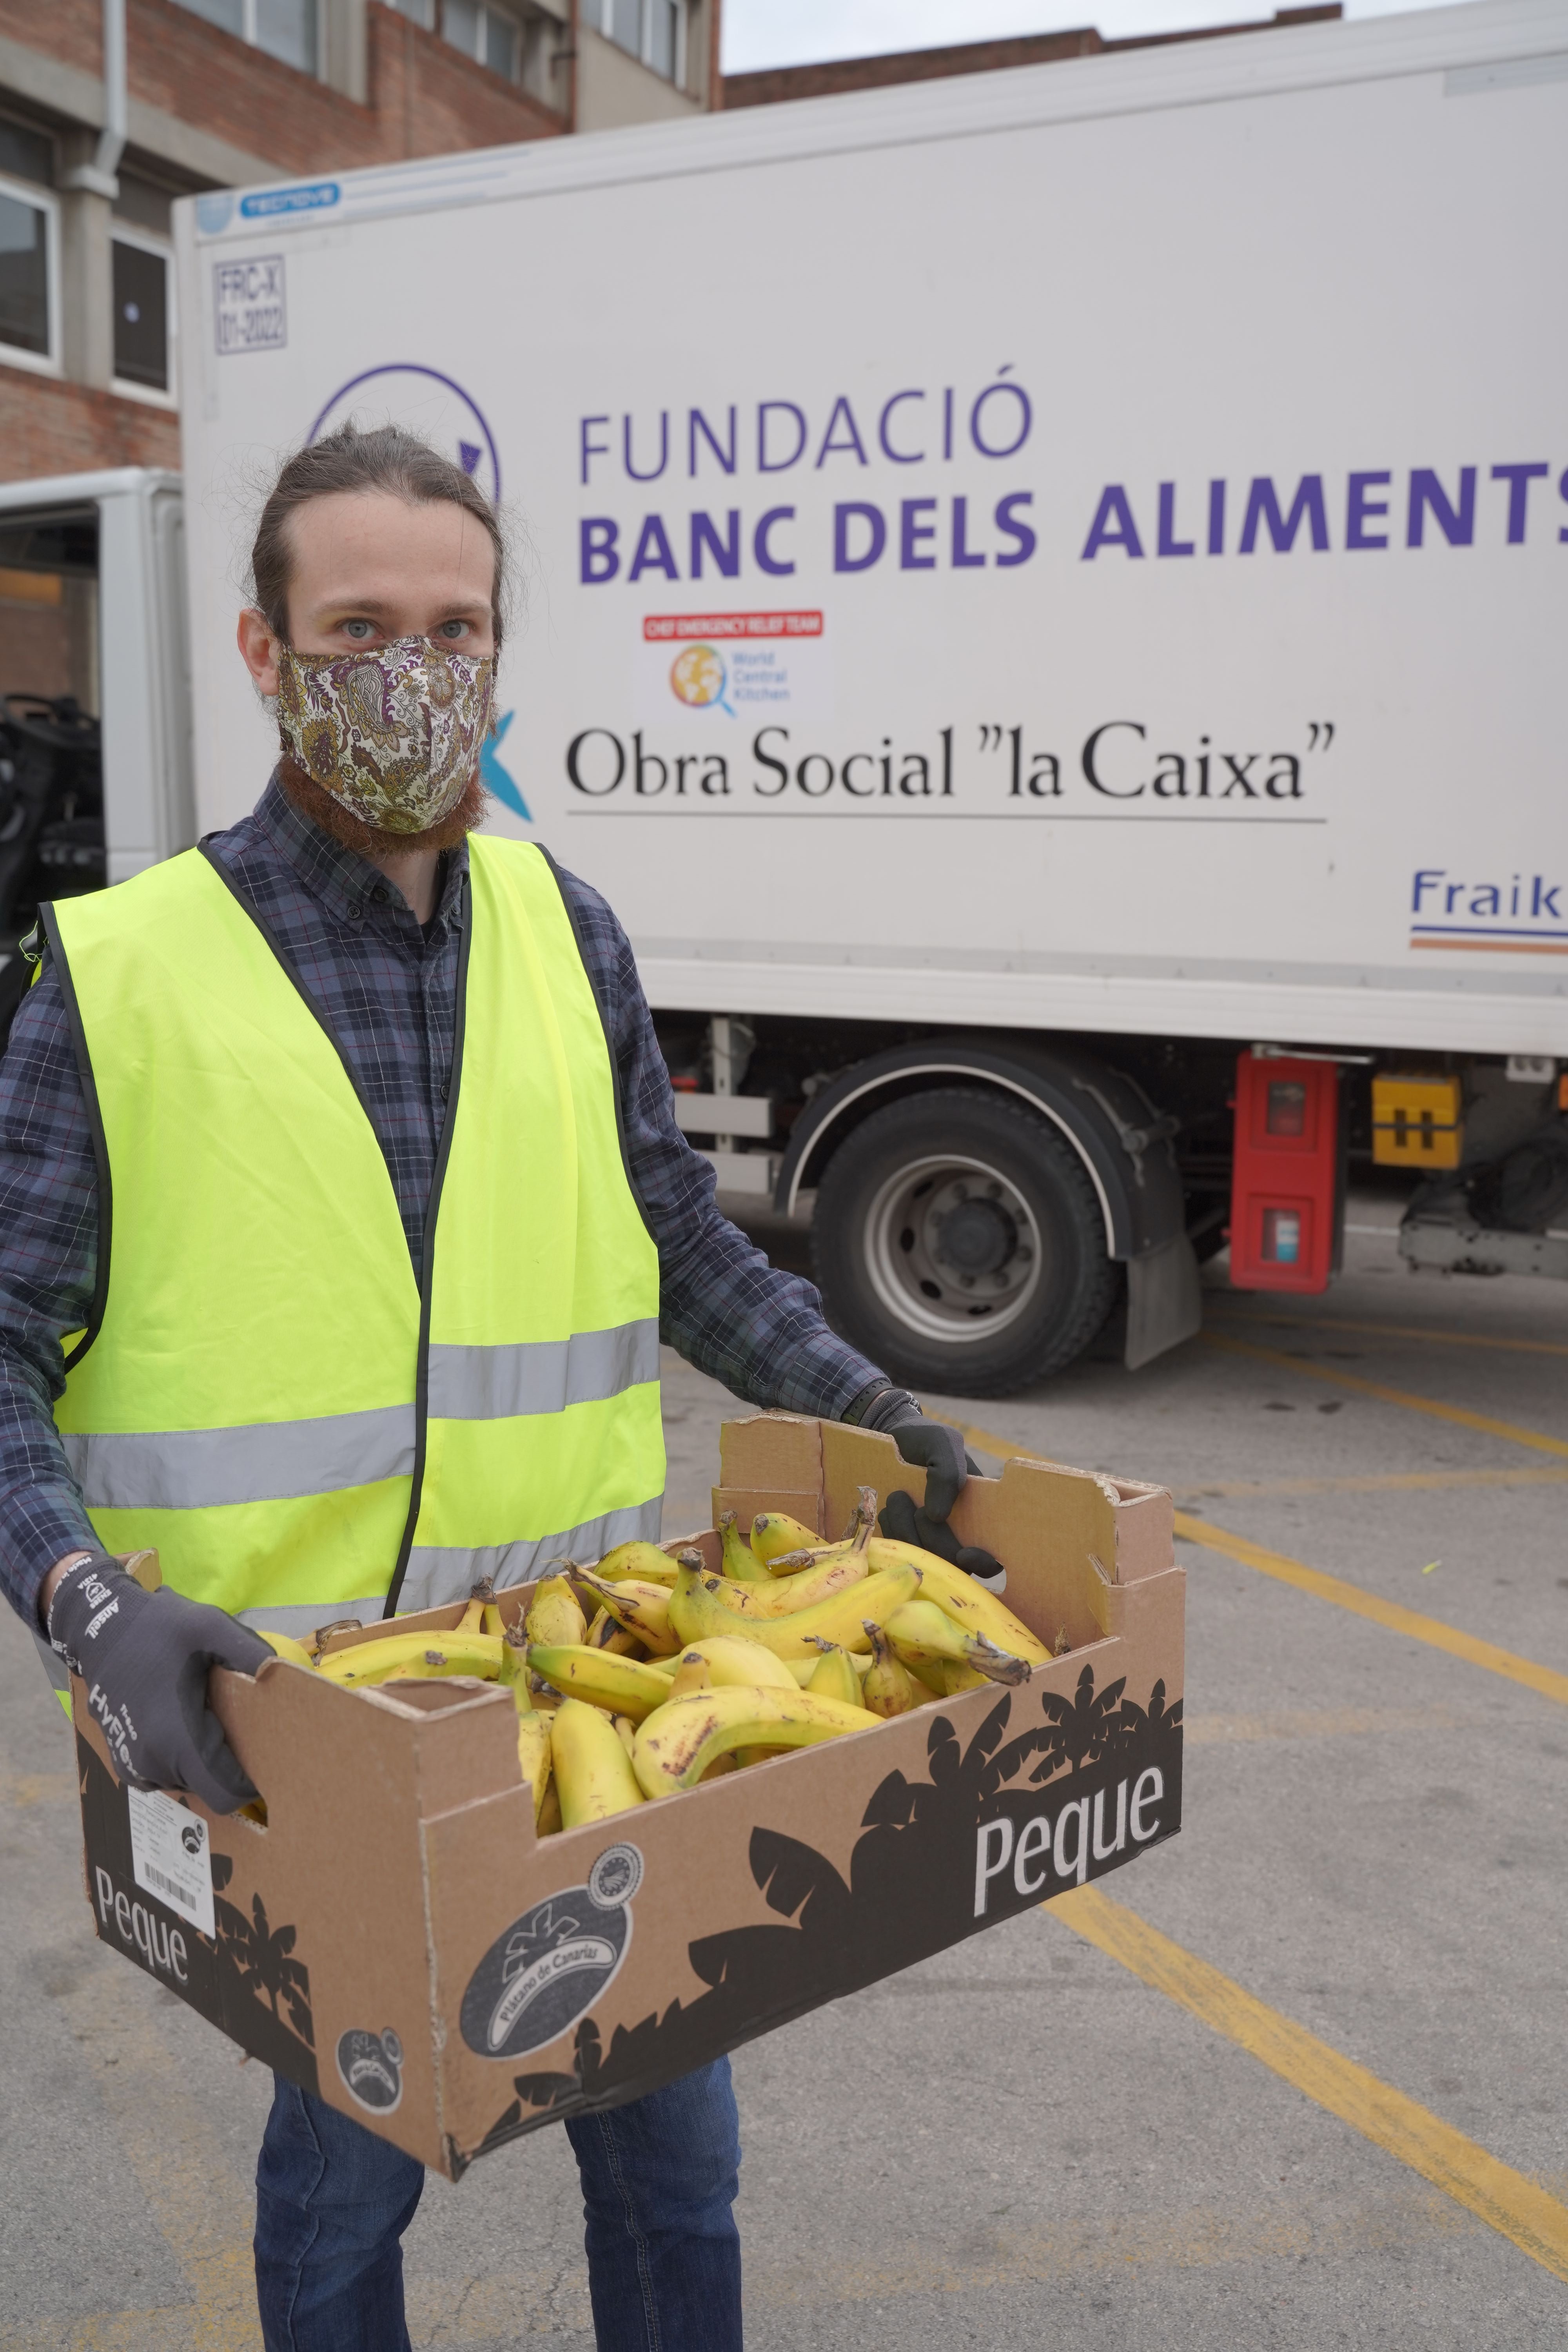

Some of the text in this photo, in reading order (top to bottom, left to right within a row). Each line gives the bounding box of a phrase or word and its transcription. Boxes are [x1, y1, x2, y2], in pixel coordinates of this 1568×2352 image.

[220, 265, 281, 301] FRC-X
[581, 365, 1032, 485] FUNDACIÓ
[580, 506, 795, 584] BANC
[834, 492, 1036, 573] DELS
[676, 617, 745, 637] EMERGENCY
[747, 615, 783, 635] RELIEF
[786, 613, 820, 633] TEAM
[732, 652, 775, 666] World
[734, 670, 787, 683] Central
[734, 688, 790, 700] Kitchen
[566, 730, 730, 795] Obra
[753, 728, 952, 796] Social
[68, 1556, 92, 1573] Made
[88, 1602, 119, 1639] Ansell
[89, 1684, 138, 1780] HyFlex
[974, 1765, 1165, 1918] Peque
[96, 1865, 189, 1980] Peque
[499, 1944, 599, 2022] Plátano de Canarias
